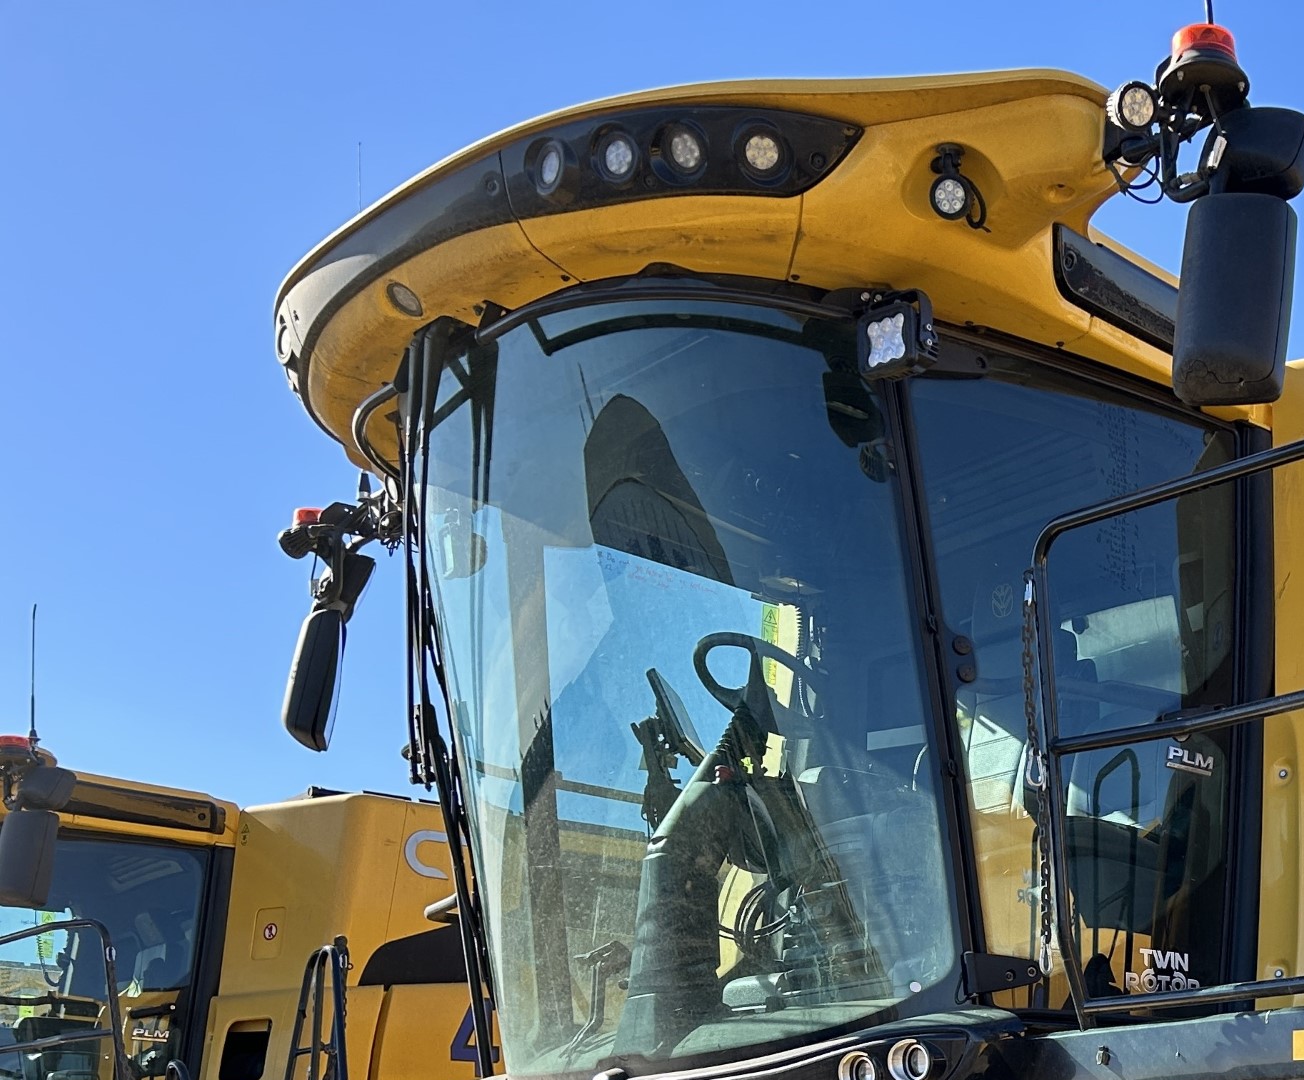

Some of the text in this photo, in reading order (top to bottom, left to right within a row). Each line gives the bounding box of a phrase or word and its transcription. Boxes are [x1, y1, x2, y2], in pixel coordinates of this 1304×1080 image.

[1167, 746, 1214, 770] PLM
[1139, 948, 1189, 972] TWIN
[132, 1028, 169, 1038] PLM
